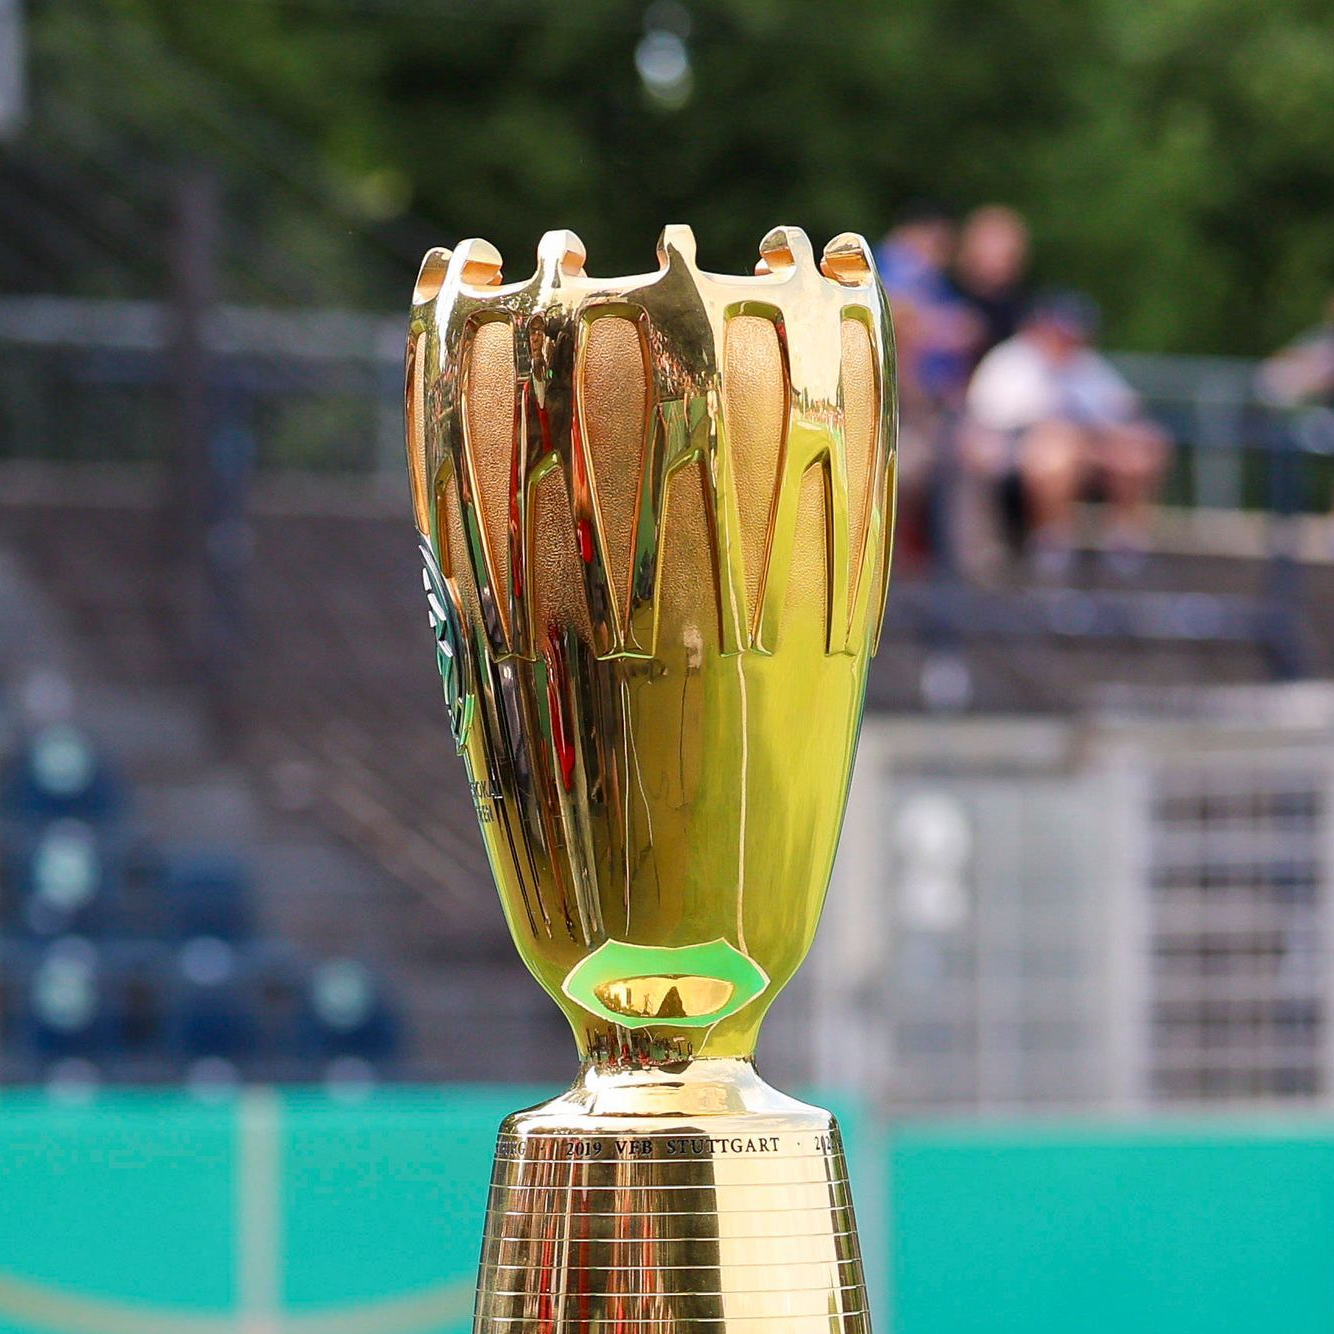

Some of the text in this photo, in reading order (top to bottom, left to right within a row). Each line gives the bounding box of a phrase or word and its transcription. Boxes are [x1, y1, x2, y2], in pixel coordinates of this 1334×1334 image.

[566, 1141, 602, 1156] 2019
[614, 1140, 653, 1155] VFB
[666, 1137, 780, 1154] STUTTGART
